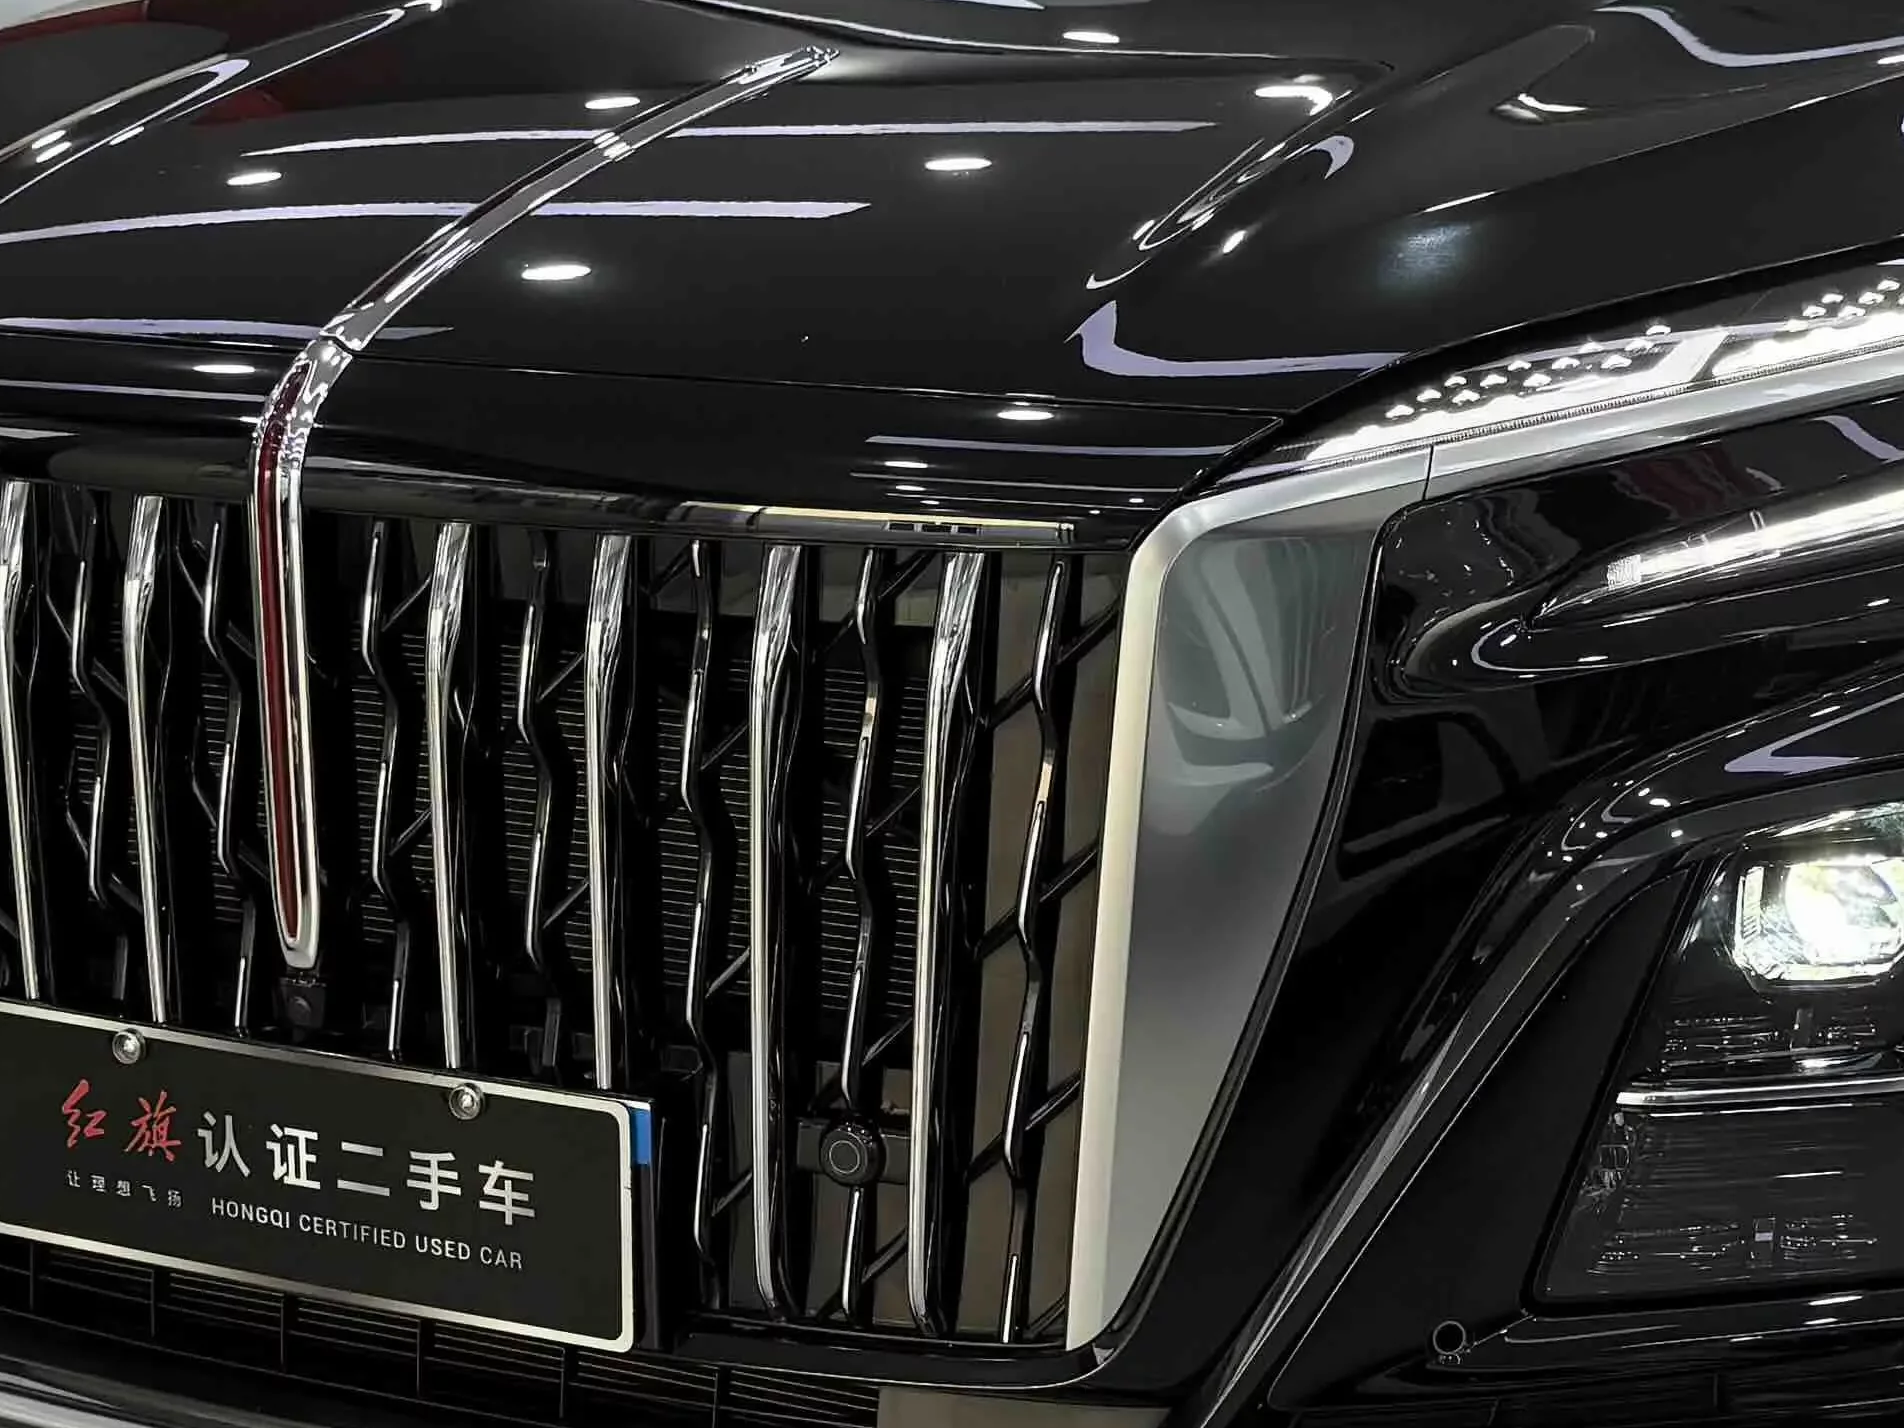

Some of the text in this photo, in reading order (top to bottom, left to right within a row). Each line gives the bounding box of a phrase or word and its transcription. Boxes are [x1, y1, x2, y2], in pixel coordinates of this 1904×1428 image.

[61, 1078, 536, 1227] 红旗认证二手车
[65, 1169, 184, 1210] 让理想飞扬
[211, 1196, 524, 1272] HONGQI CERTIFIED USED CAR
